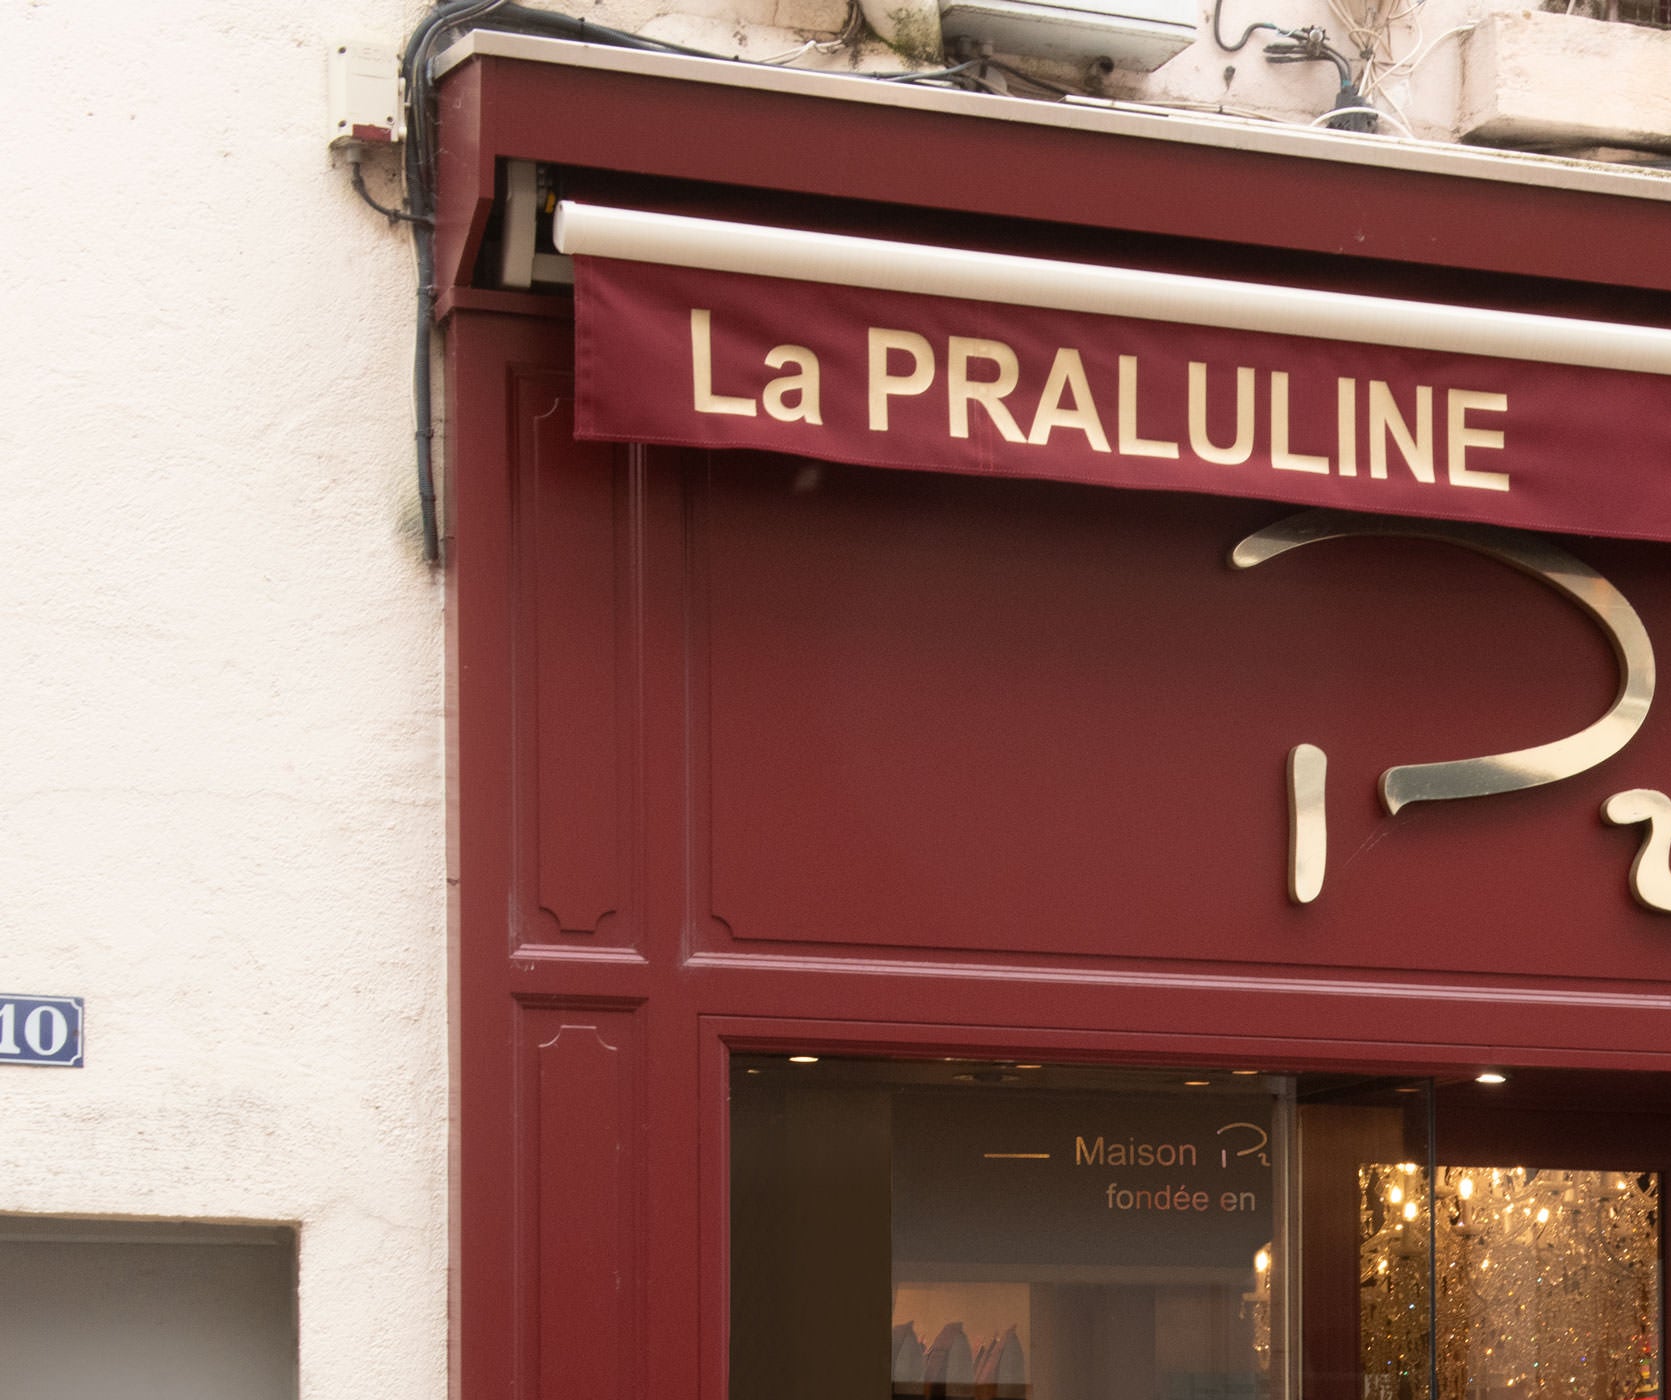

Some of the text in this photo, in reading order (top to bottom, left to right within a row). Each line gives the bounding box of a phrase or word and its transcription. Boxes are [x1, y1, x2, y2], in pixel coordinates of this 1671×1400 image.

[690, 308, 1510, 492] La PRALULINE
[0, 1003, 68, 1056] 10
[1076, 1136, 1196, 1166] Maison
[1105, 1183, 1256, 1211] fondée en
